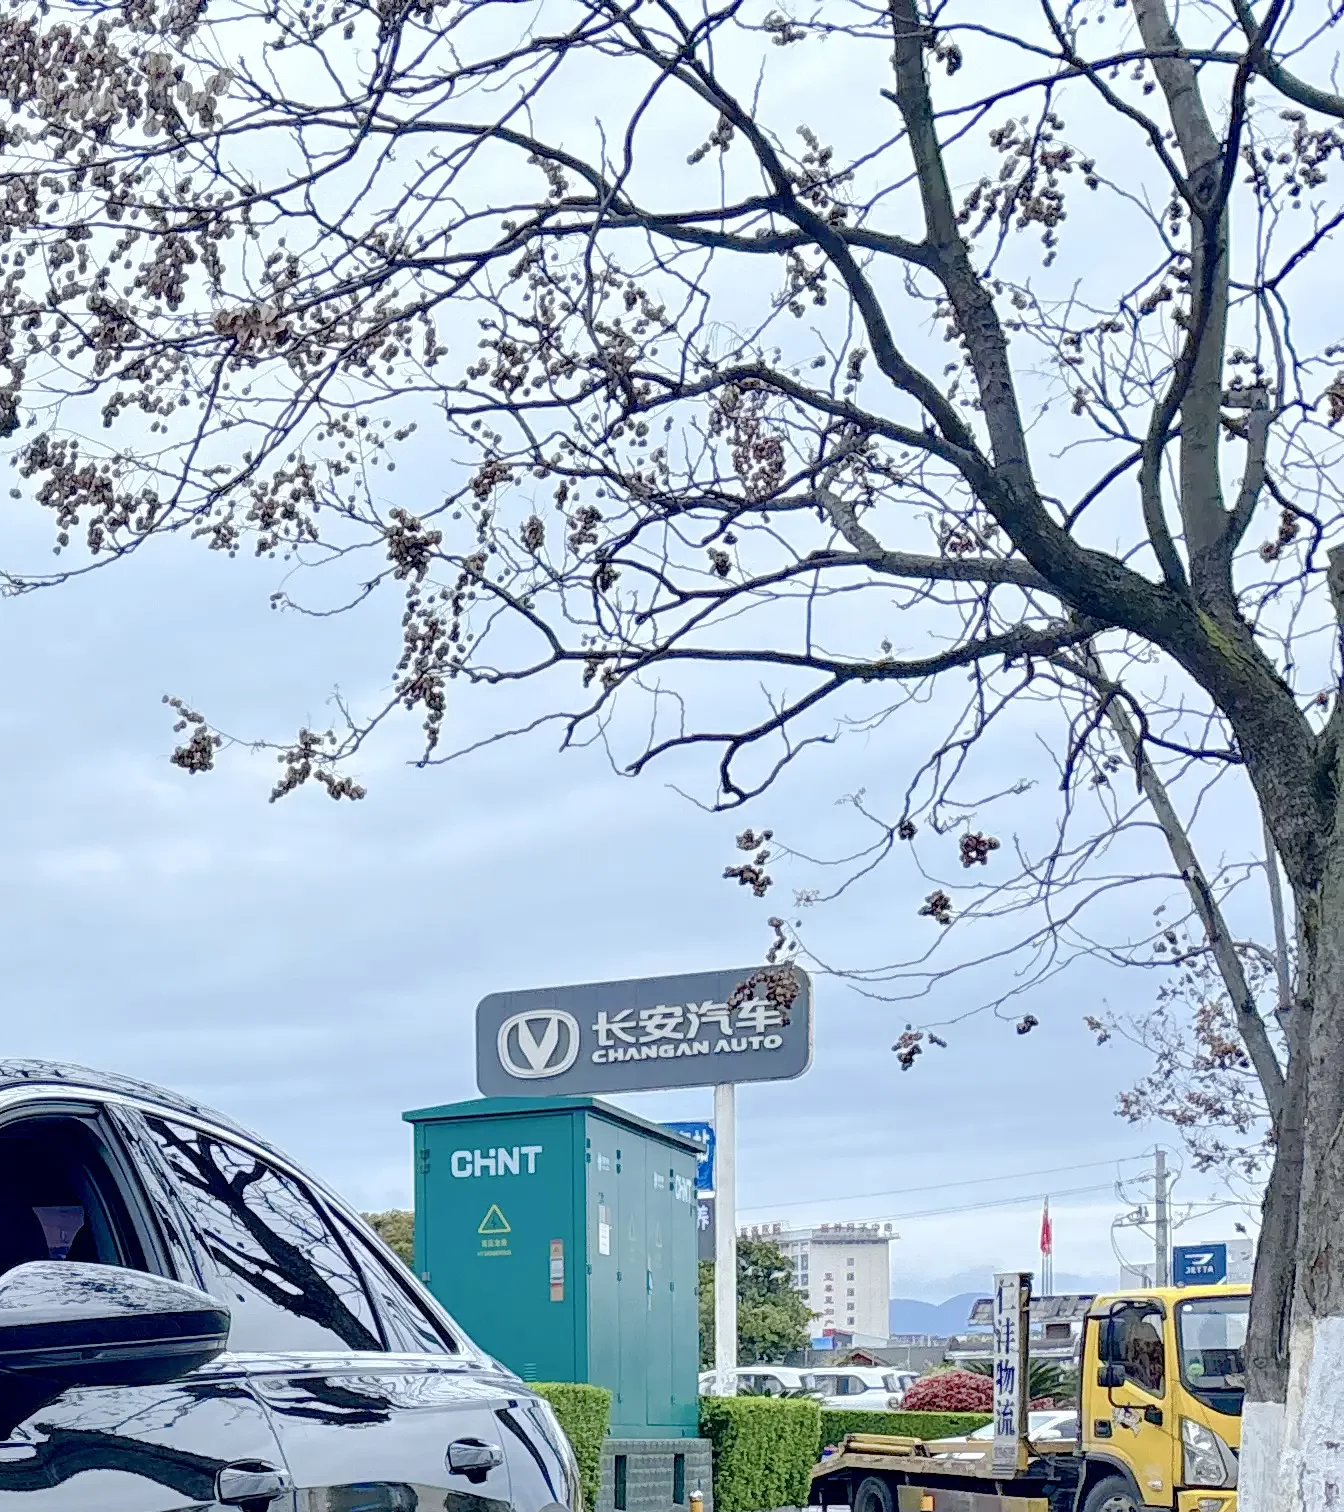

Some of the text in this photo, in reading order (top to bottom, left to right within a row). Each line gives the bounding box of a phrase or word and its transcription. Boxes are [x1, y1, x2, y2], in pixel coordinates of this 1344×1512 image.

[591, 997, 784, 1047] 长安汽车
[591, 1034, 783, 1064] CHANGAN AUTO
[1184, 1265, 1215, 1275] JETTA
